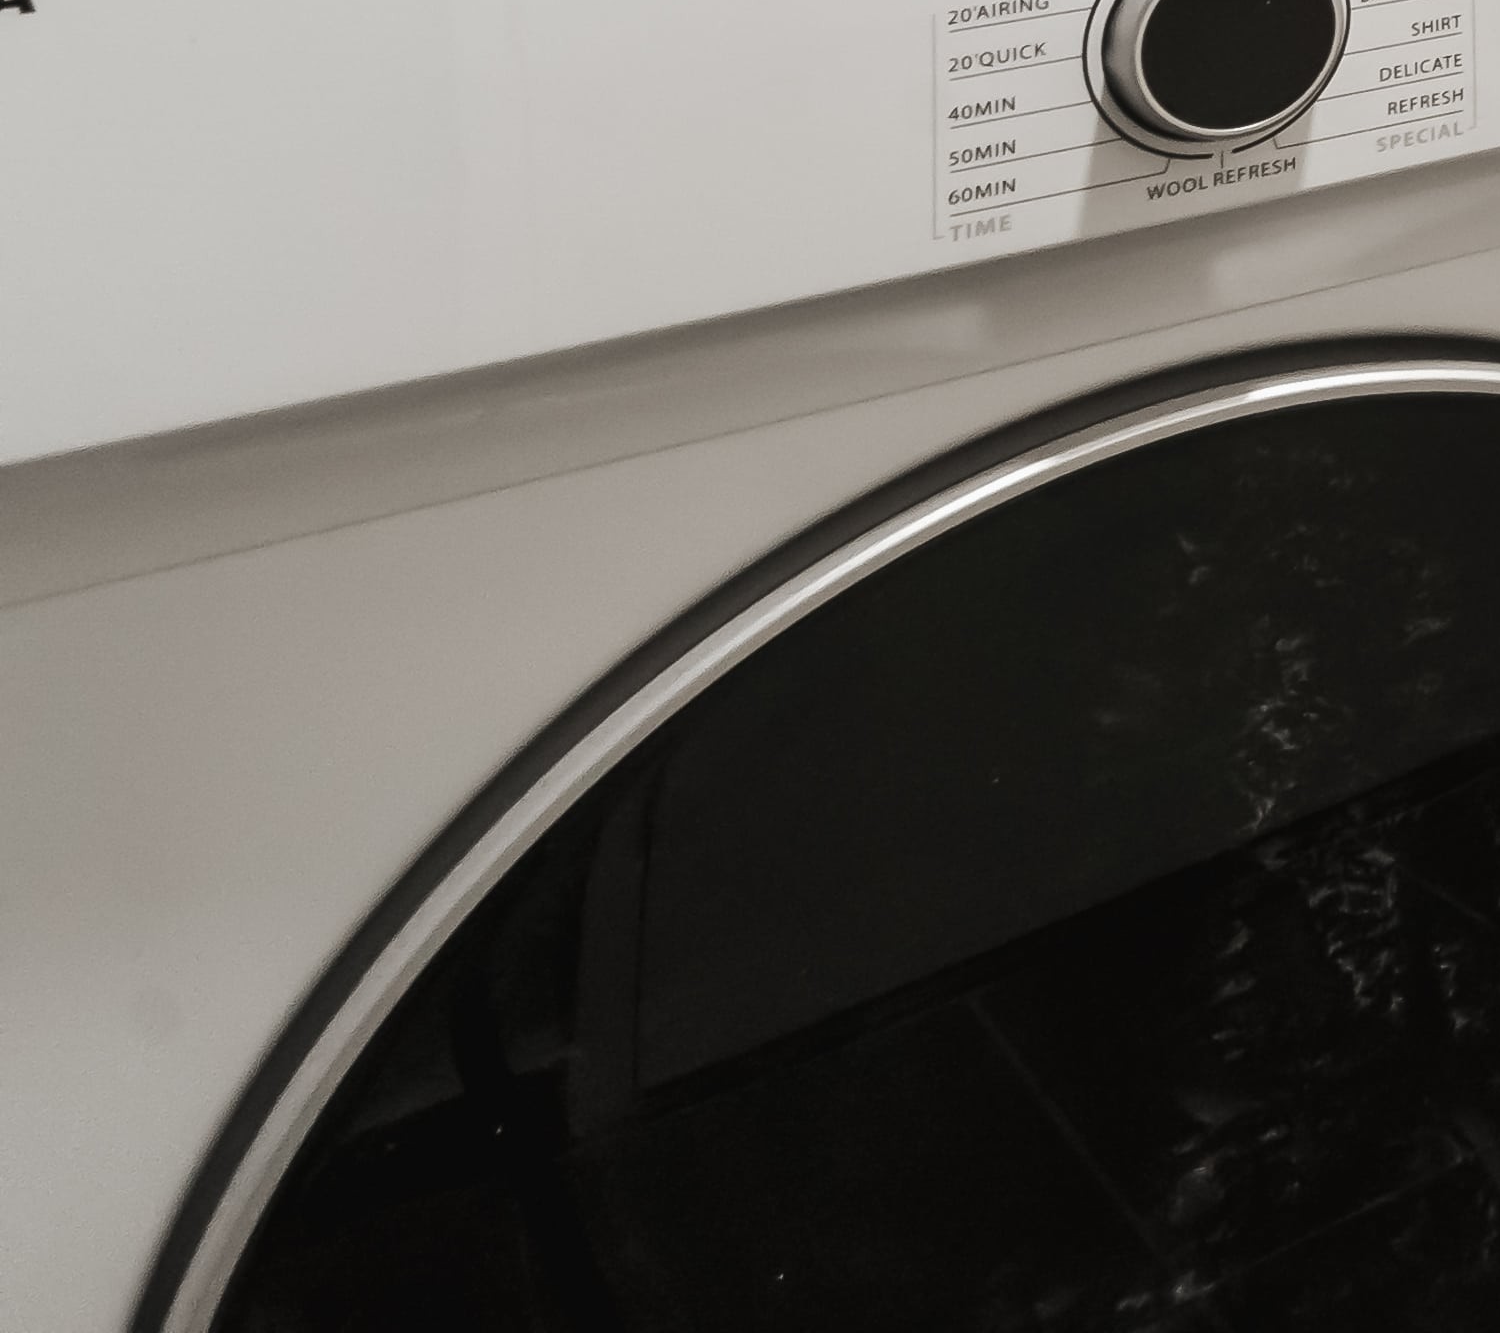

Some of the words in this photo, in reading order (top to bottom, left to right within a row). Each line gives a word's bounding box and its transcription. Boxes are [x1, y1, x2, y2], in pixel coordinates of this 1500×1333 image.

[1411, 15, 1461, 36] SHIRT
[948, 42, 1047, 73] 20'QUICK
[1380, 53, 1462, 82] DELICATE
[948, 96, 1016, 120] 40MIN
[1388, 88, 1464, 115] REFRESH
[1376, 121, 1464, 153] SPECIAL
[949, 139, 1016, 166] 50MIN
[948, 178, 1016, 205] 60MIN
[1146, 176, 1208, 200] WOOL
[1213, 157, 1296, 186] REFRESH
[950, 215, 1012, 242] TIME
